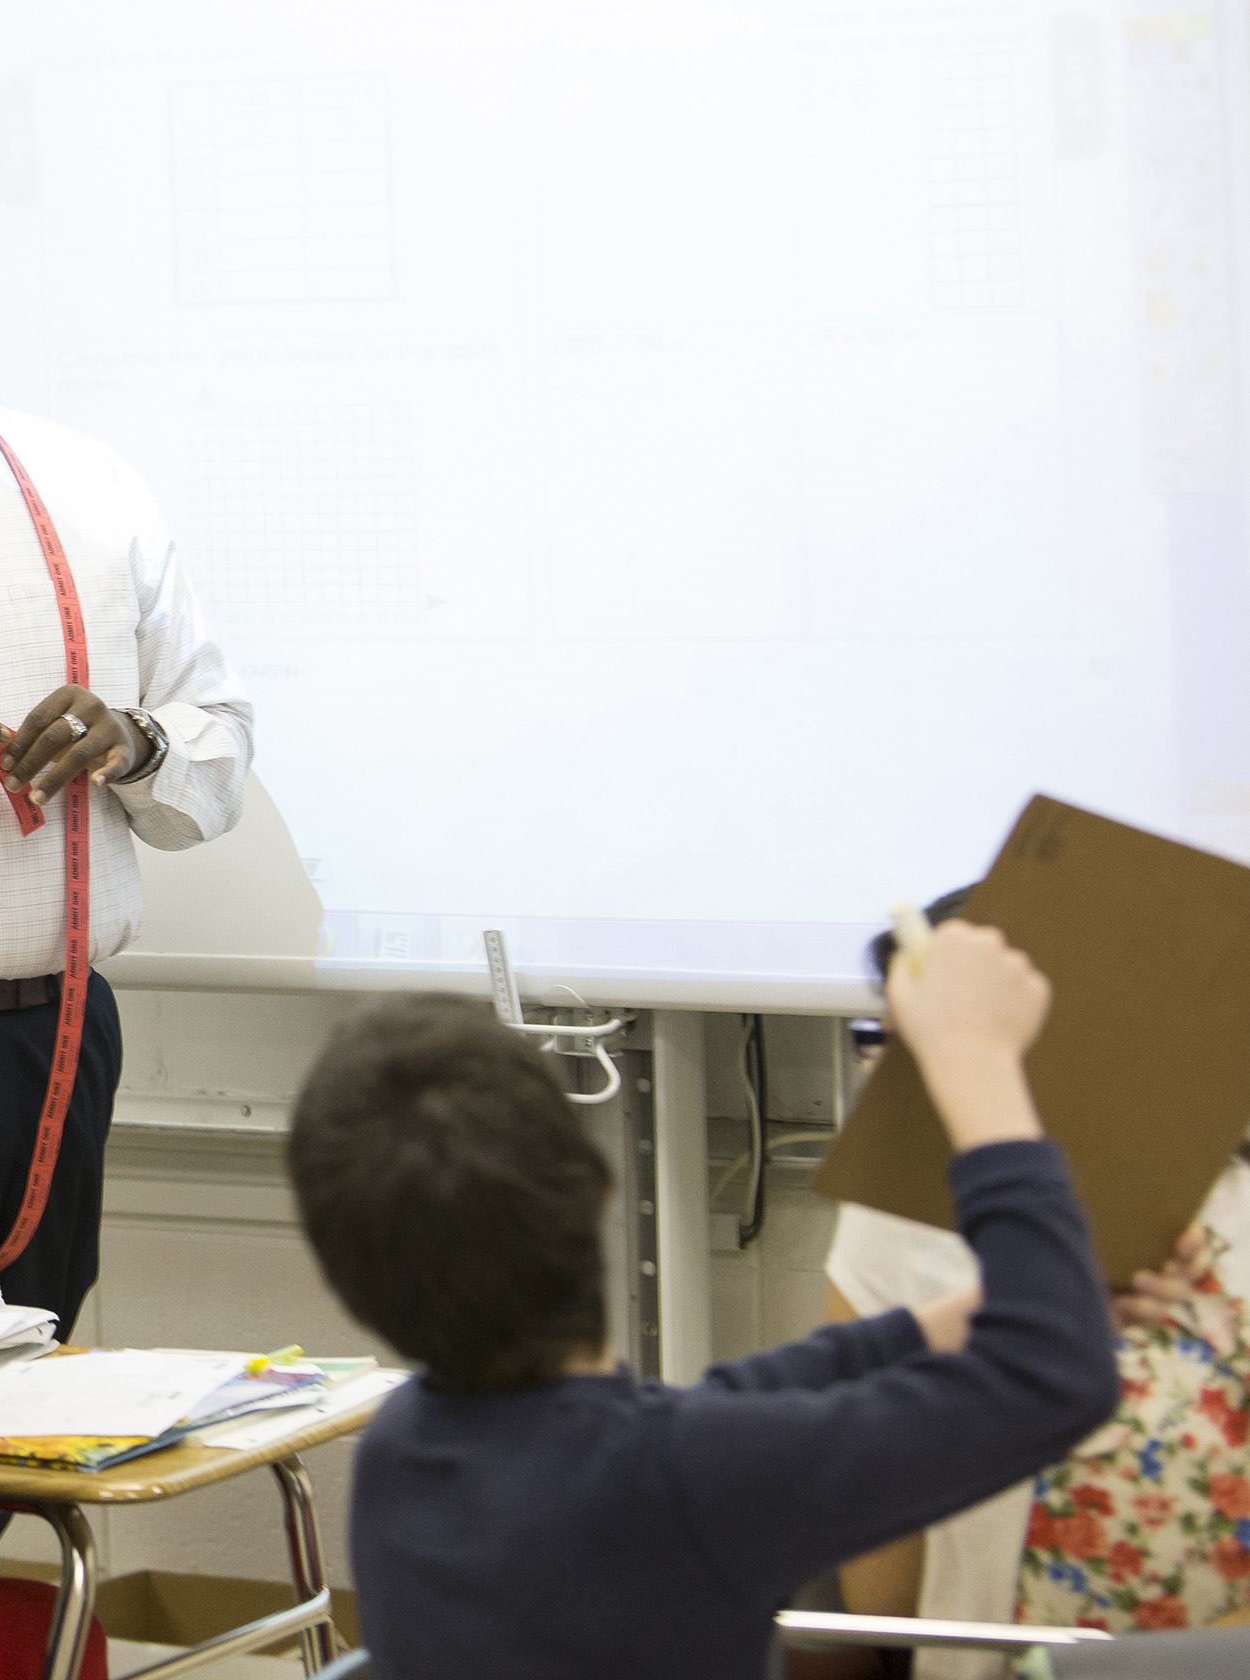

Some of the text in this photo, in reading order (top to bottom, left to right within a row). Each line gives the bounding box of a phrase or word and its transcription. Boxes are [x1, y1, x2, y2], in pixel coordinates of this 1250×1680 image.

[57, 576, 67, 597] ADMIT
[63, 606, 75, 642] ADMIT ONE
[70, 651, 78, 667] ONE
